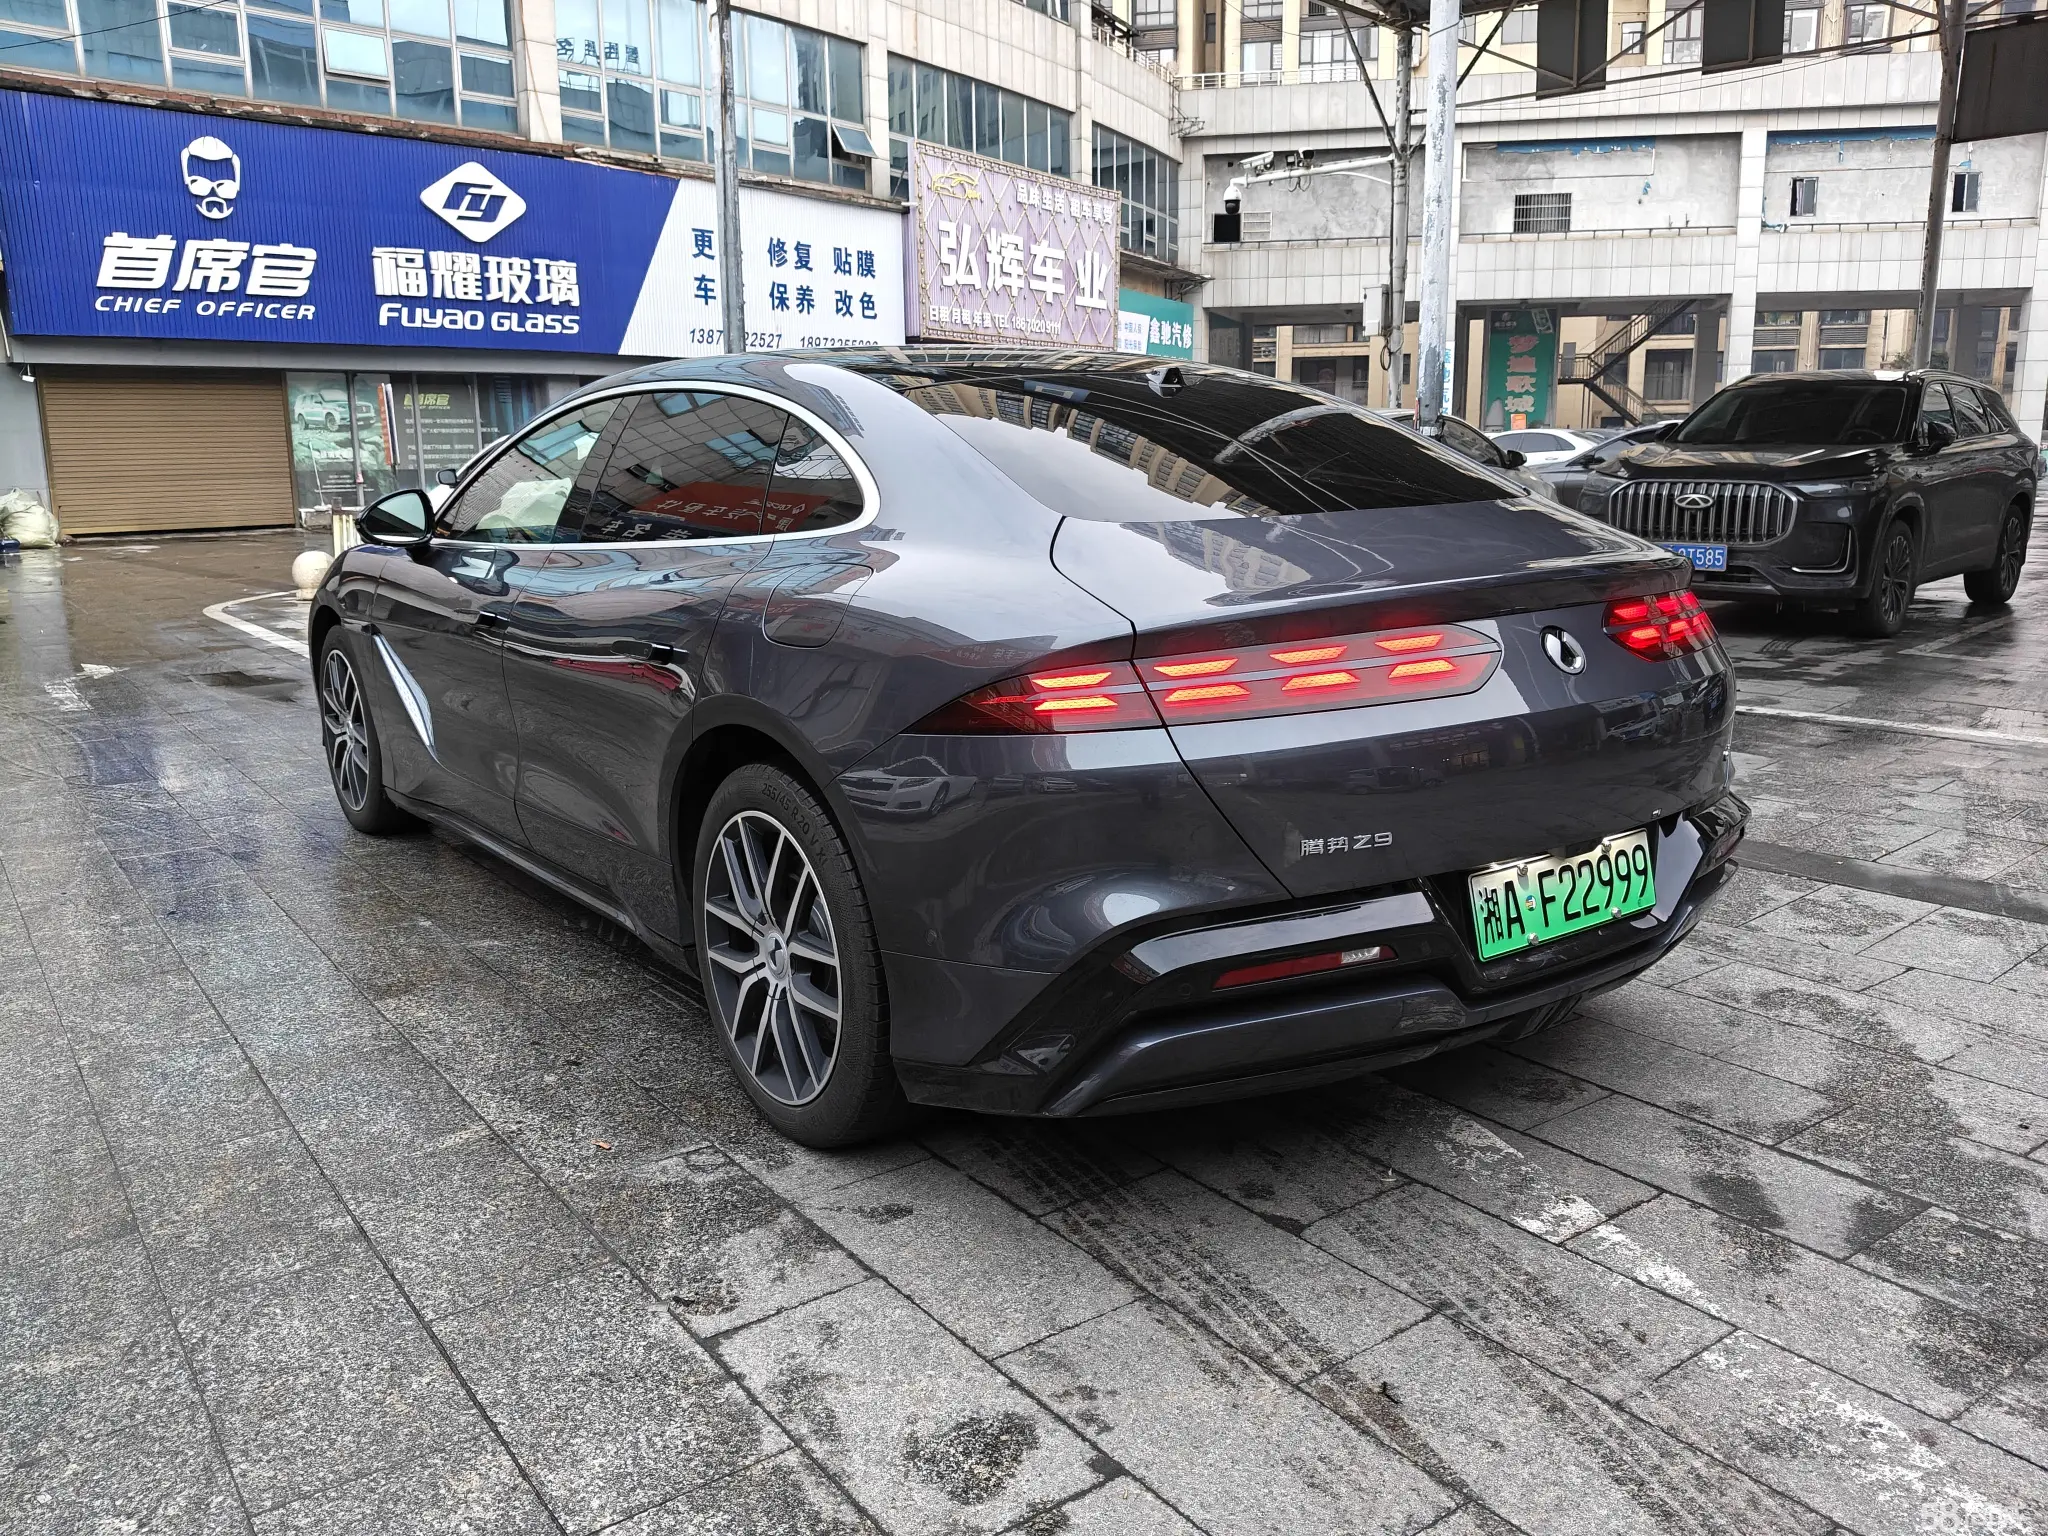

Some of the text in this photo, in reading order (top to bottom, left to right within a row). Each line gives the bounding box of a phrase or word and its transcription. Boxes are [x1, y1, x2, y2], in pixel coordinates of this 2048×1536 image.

[1017, 183, 1065, 214] 品味生活
[96, 232, 317, 297] 首席官
[767, 237, 813, 272] 修复
[833, 246, 876, 279] 贴膜
[938, 219, 1107, 310] 弘辉车业
[372, 247, 580, 307] 福耀玻璃
[95, 295, 316, 320] CHIEF OFFICER
[769, 281, 815, 315] 保养
[834, 290, 877, 320] 改色
[994, 314, 1009, 329] TEL
[1149, 317, 1192, 349] 鑫驰汽修
[1300, 831, 1393, 857] 腾势 Z9
